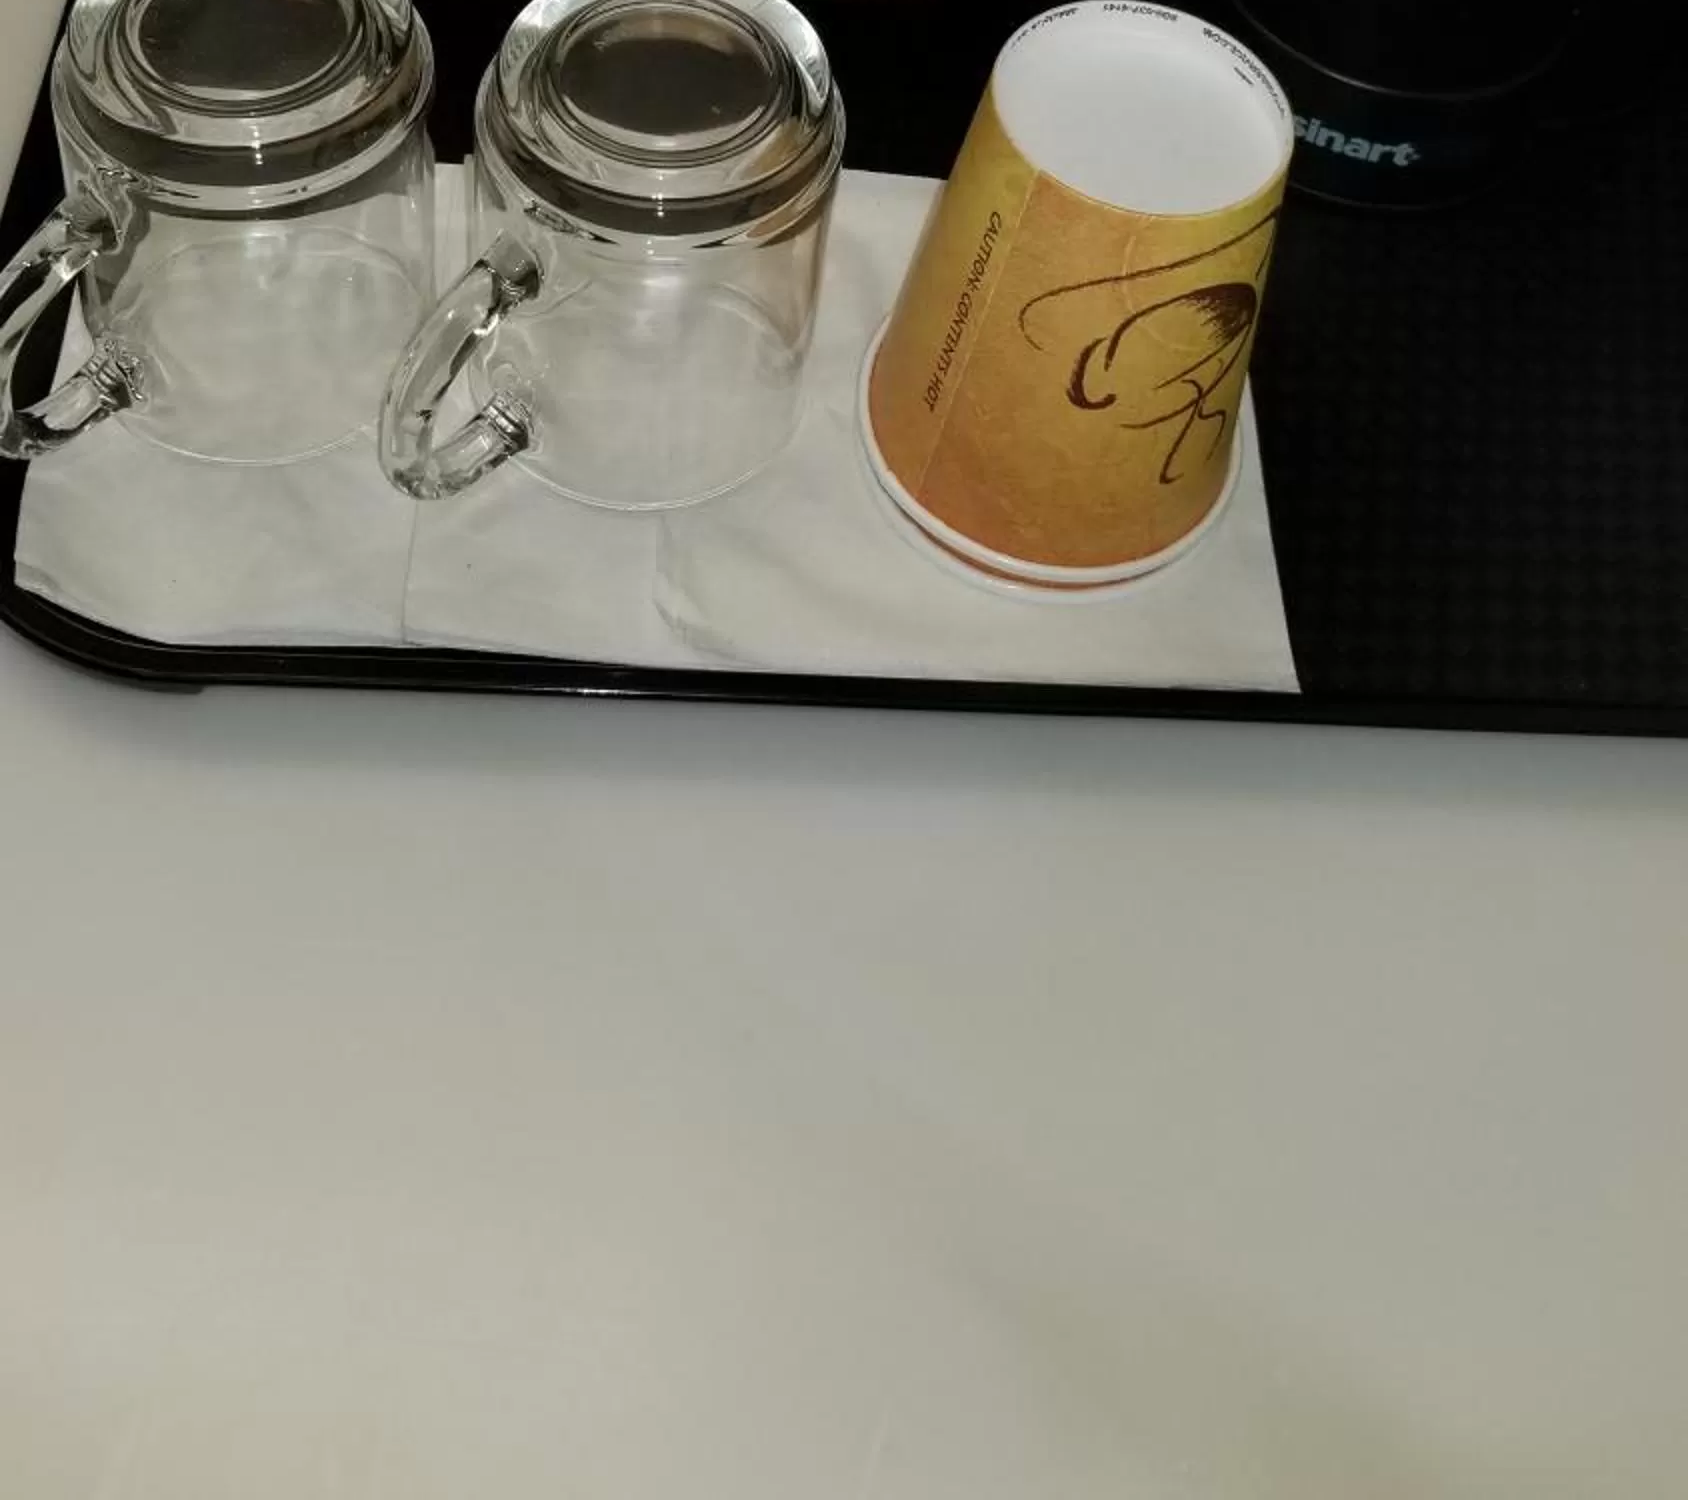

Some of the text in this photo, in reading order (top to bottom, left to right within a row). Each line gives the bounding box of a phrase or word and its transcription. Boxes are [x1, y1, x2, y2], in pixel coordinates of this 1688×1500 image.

[1294, 115, 1415, 167] sinart
[937, 291, 971, 376] CONTENTS
[923, 374, 946, 414] HOT
